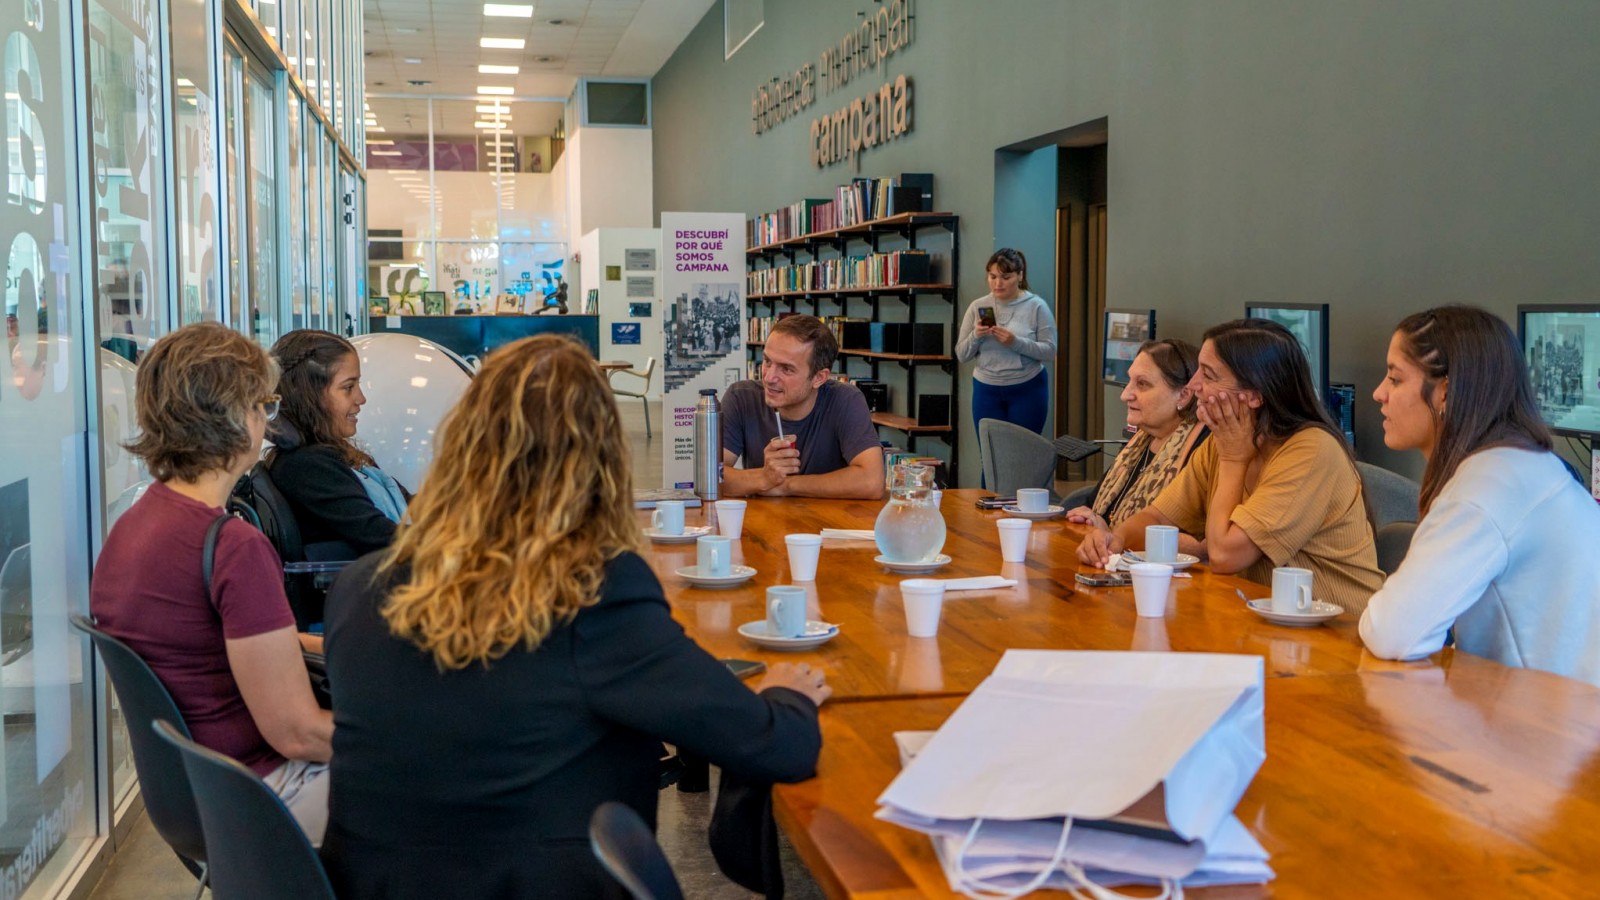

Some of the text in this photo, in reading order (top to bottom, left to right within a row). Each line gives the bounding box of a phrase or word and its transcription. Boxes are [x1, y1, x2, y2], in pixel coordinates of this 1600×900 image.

[809, 74, 908, 173] campana
[675, 229, 729, 239] DESCUBRÍ
[675, 240, 723, 250] POR QUÉ
[675, 252, 714, 261] SOMOS
[675, 263, 729, 272] CAMPANA
